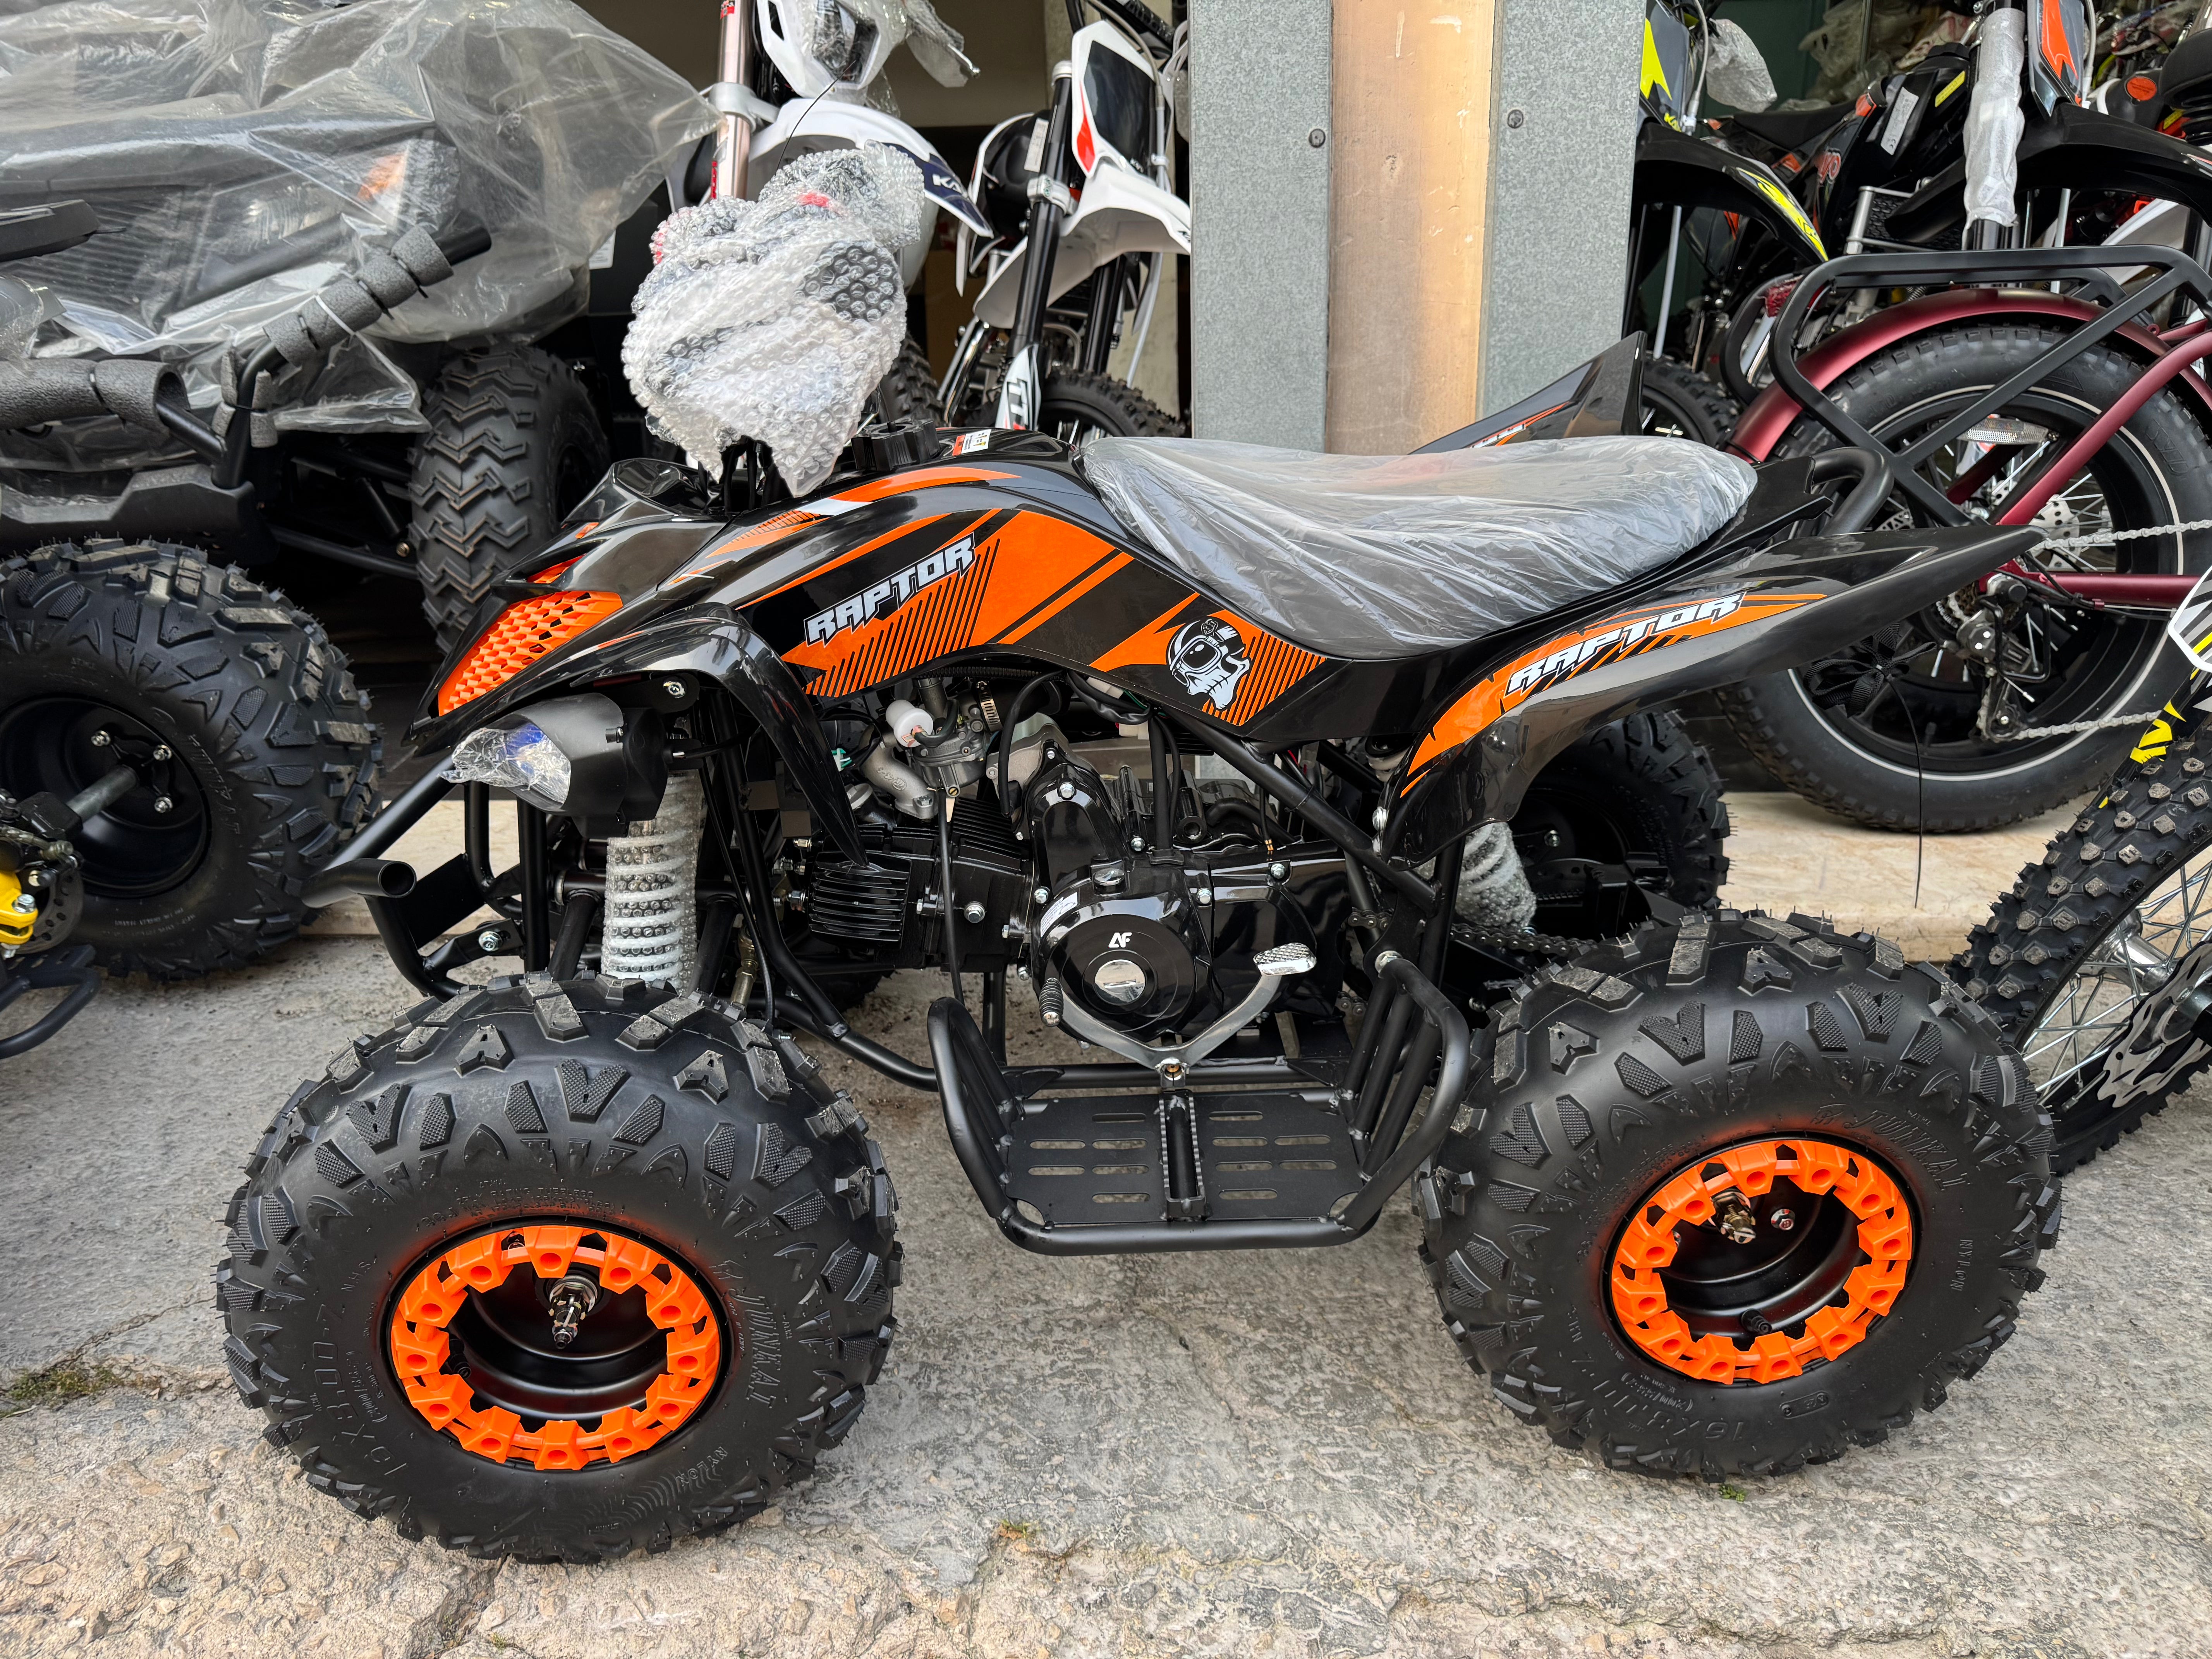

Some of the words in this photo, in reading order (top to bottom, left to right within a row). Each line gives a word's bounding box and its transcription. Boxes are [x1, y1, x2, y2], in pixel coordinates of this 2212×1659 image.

[805, 532, 975, 647] RAPTOR
[1506, 592, 1746, 696] RAPTOR
[537, 1187, 595, 1198] TUBELESS
[1949, 1238, 1975, 1292] NYLON
[727, 1279, 785, 1409] JUNKAI
[672, 1446, 732, 1487] NYLON
